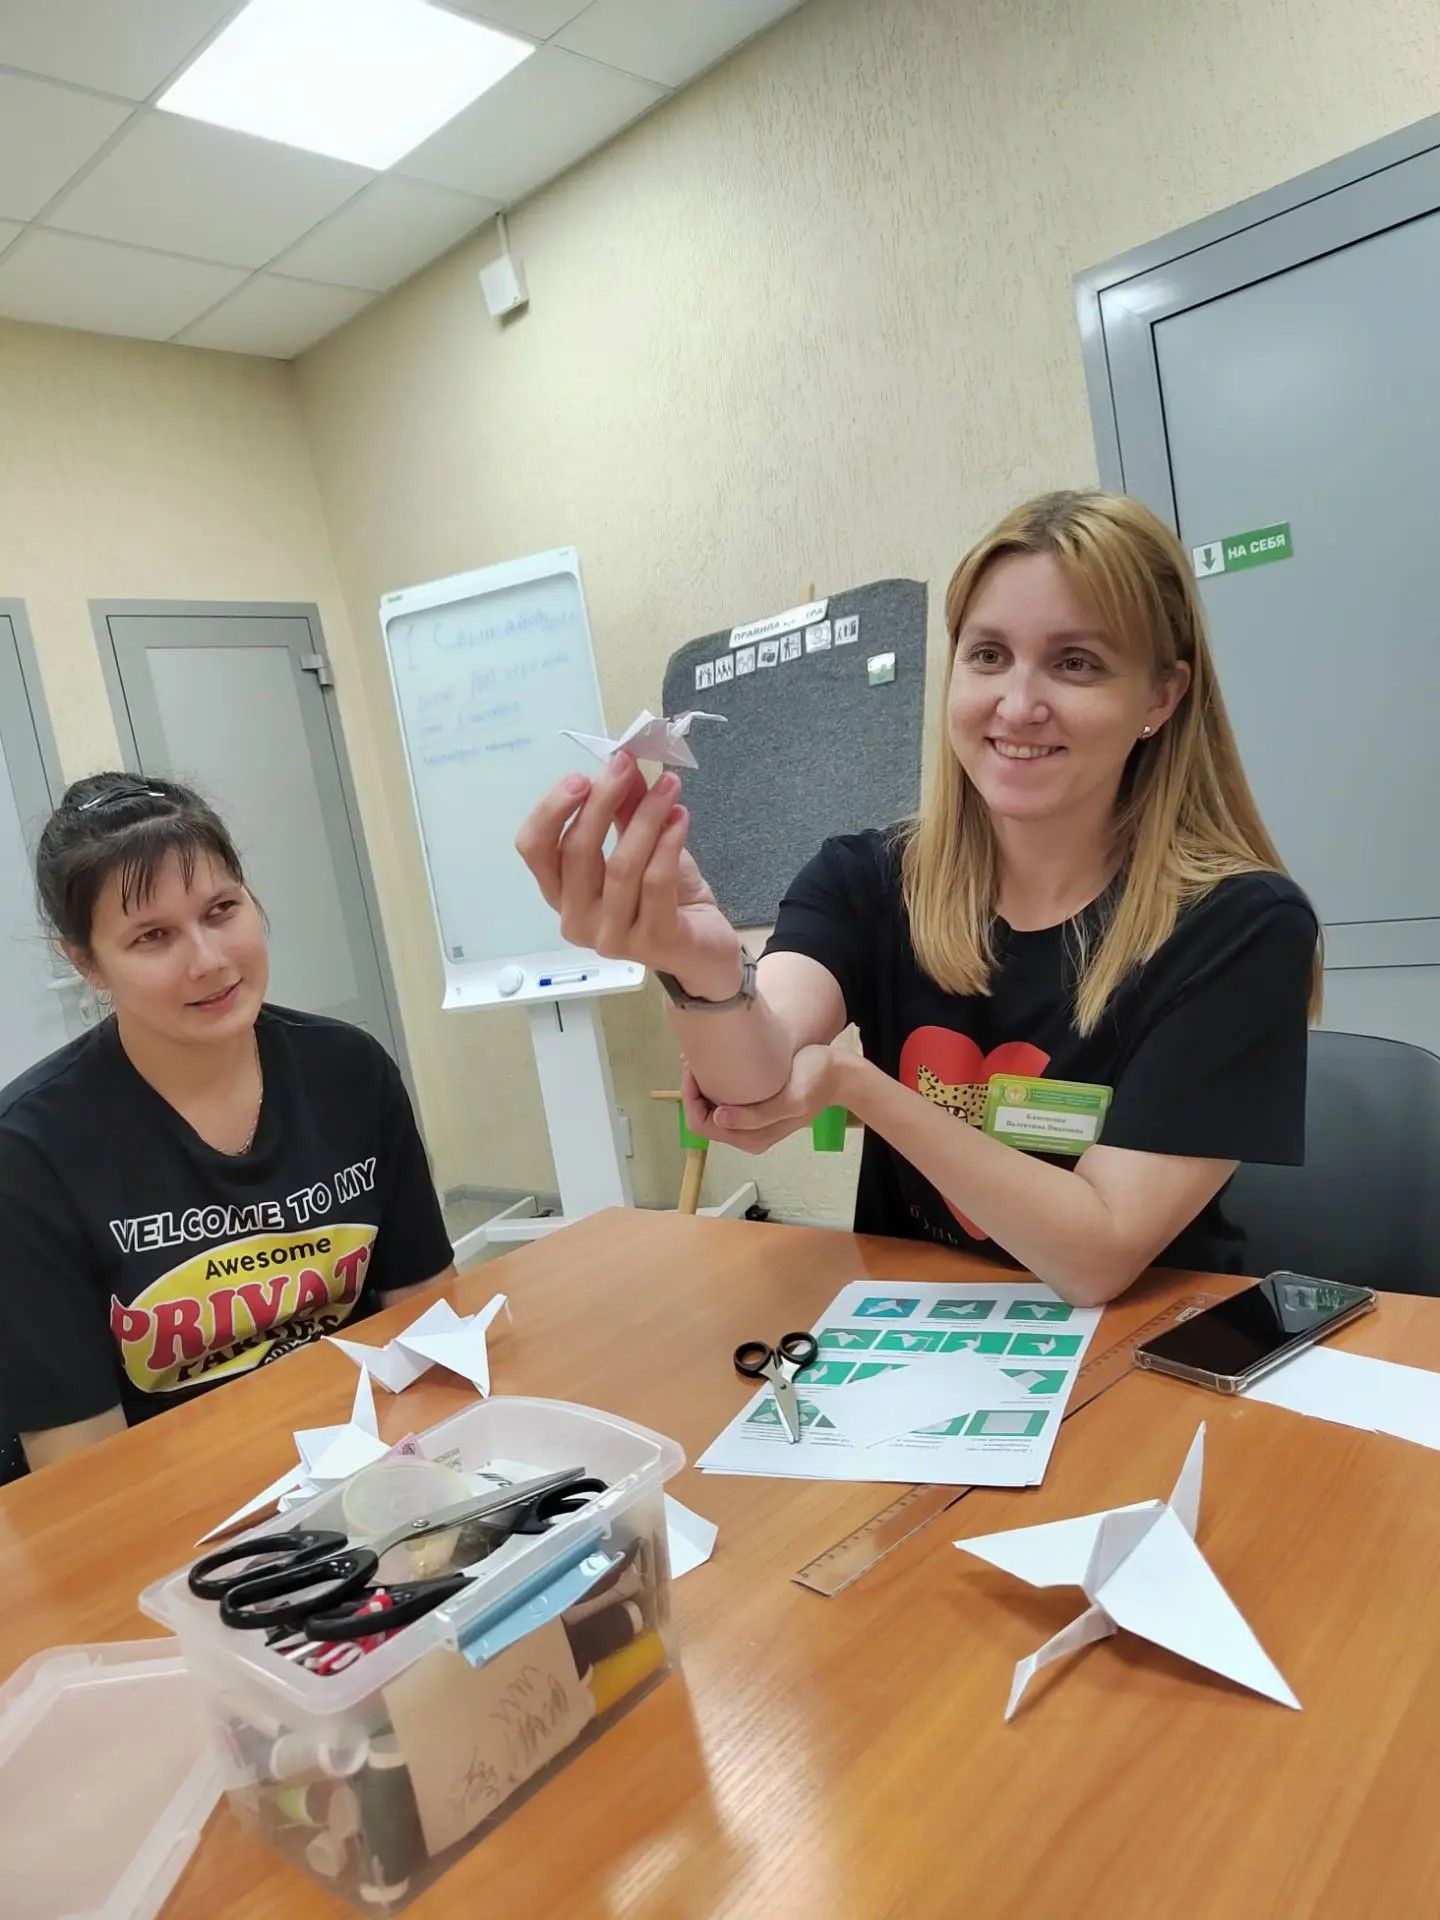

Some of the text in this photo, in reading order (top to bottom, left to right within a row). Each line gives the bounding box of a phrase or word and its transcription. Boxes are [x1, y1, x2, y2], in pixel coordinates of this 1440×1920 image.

[1227, 533, 1286, 560] НА СЕБЯ
[734, 621, 780, 641] ПРАВИЛА
[286, 1182, 332, 1224] TO
[334, 1157, 377, 1204] MY
[204, 1237, 332, 1281] Awesome
[109, 1242, 375, 1372] PRIVAT
